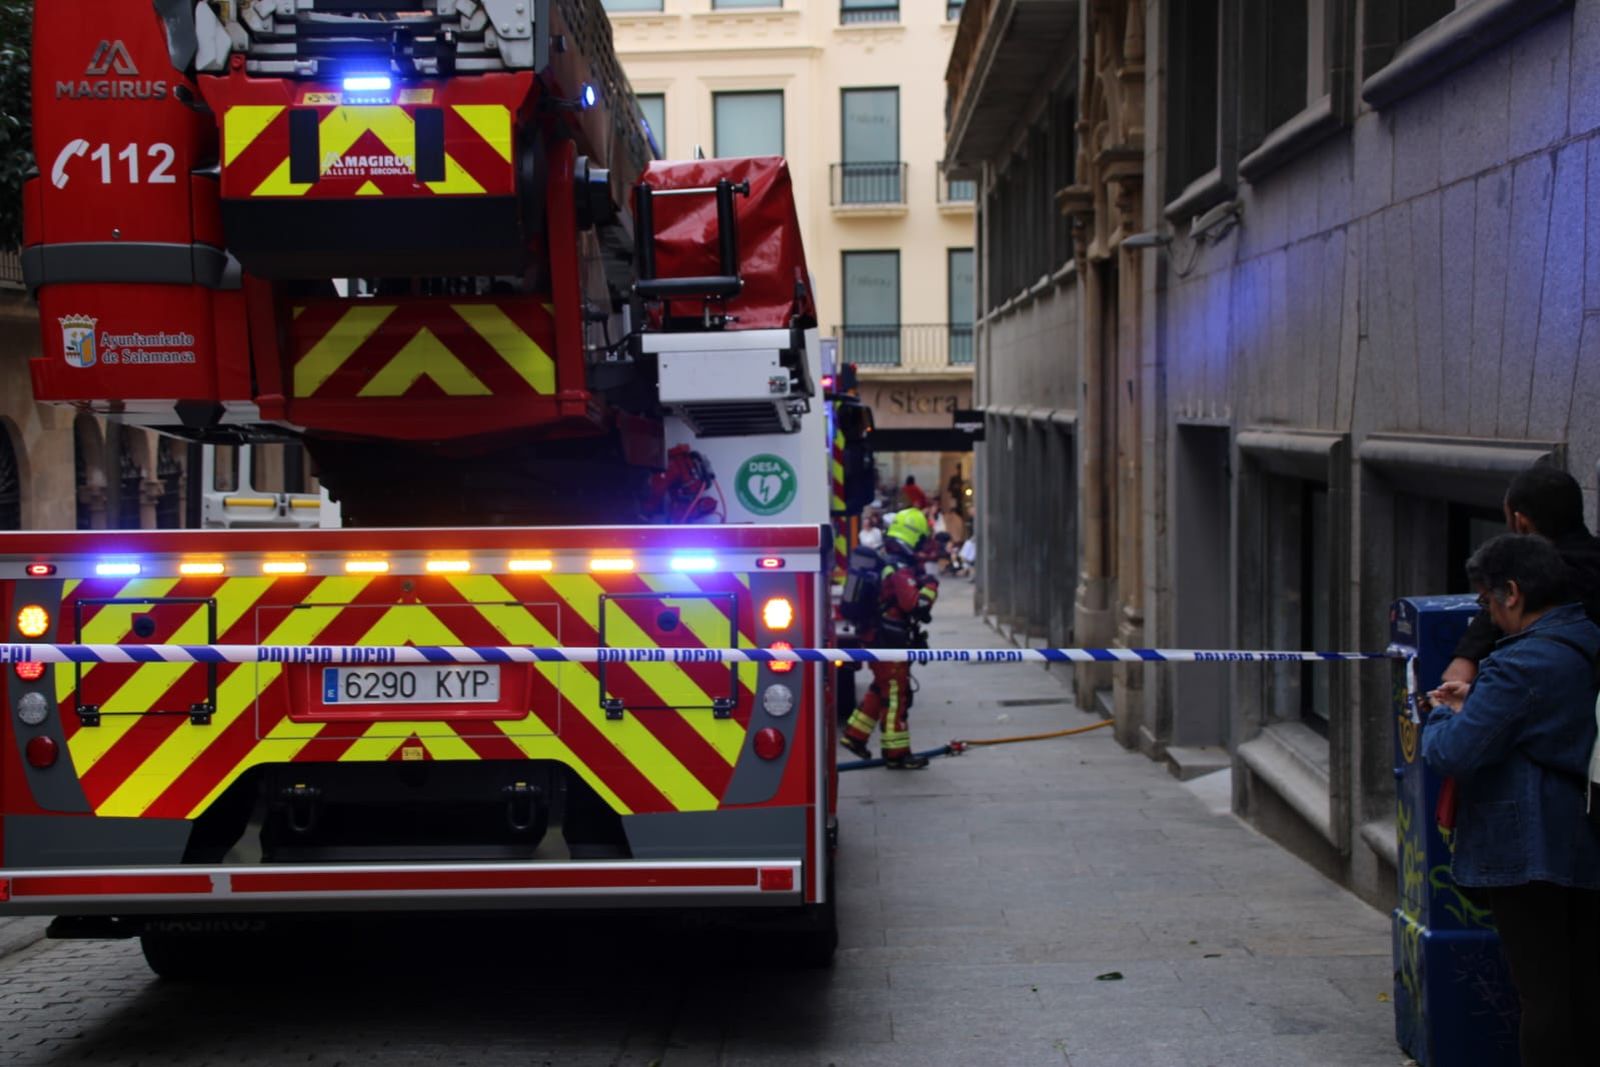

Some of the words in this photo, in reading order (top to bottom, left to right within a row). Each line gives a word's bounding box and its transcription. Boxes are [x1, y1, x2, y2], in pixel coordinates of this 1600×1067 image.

[55, 80, 167, 99] MAGIRUS
[91, 142, 177, 185] 112
[345, 155, 414, 168] MAGIRUS
[101, 331, 195, 349] Ayuntamiento
[102, 349, 119, 364] de
[121, 348, 196, 364] Salamanca
[749, 462, 781, 473] DESA
[345, 671, 417, 699] 6290
[436, 670, 490, 698] KYP
